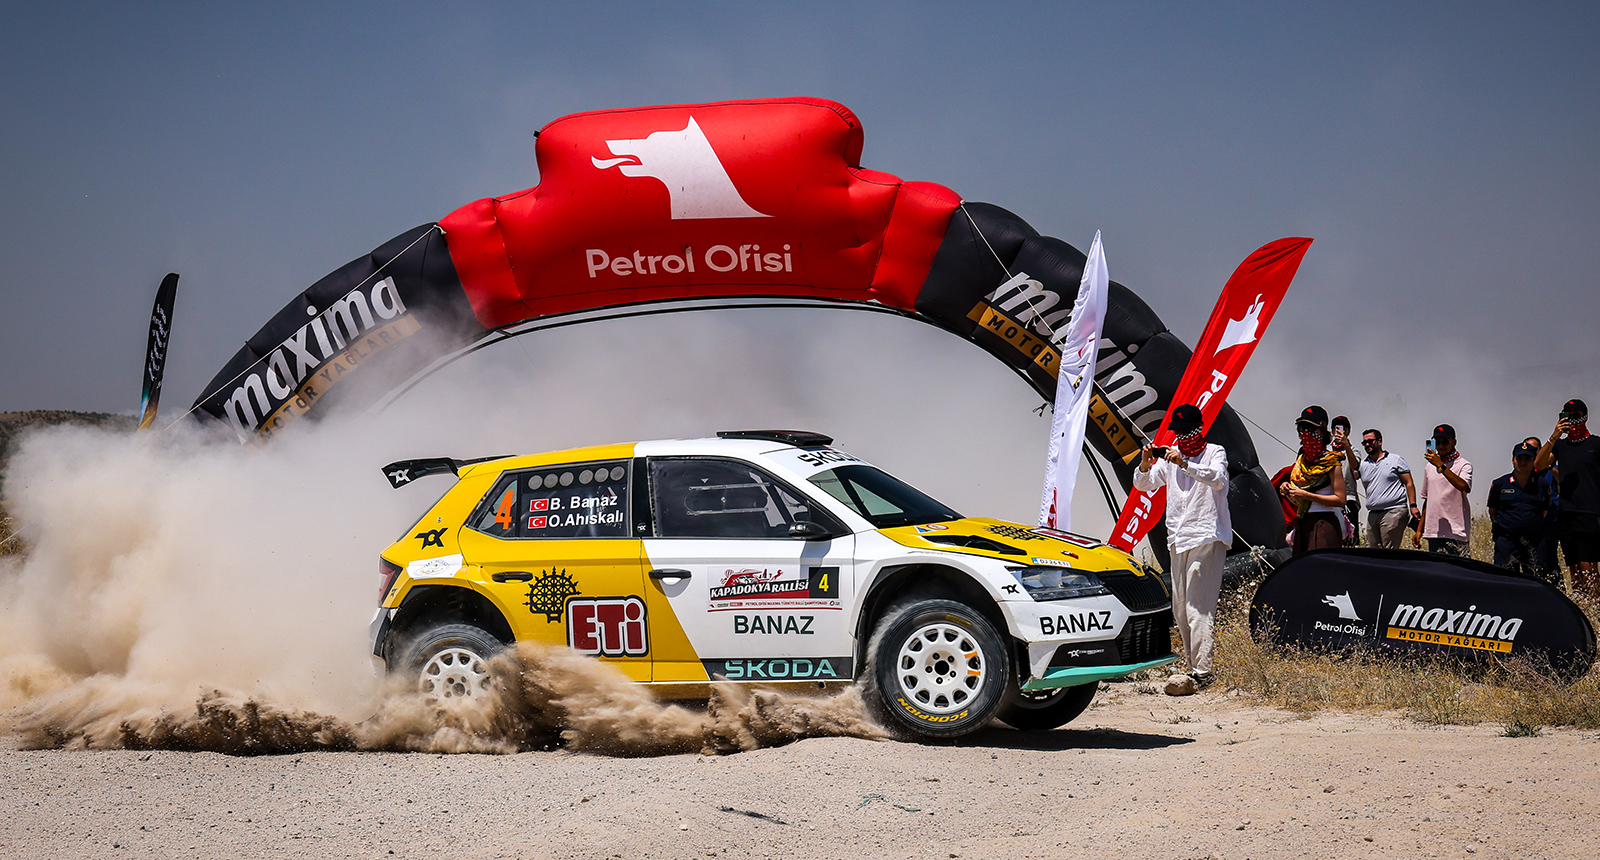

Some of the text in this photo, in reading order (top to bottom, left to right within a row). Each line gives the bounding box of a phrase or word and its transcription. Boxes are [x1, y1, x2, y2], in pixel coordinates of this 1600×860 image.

[586, 244, 793, 278] Petrol Ofisi
[987, 313, 1055, 368] MOTOR
[223, 276, 407, 445] maxima
[259, 325, 402, 442] MOTOR YAĞLARI
[495, 490, 515, 530] 4
[550, 498, 566, 511] B.
[570, 495, 618, 509] Banaz
[711, 582, 771, 598] KAPADOKYA
[818, 573, 829, 592] 4
[734, 615, 815, 635] BANAZ
[1040, 610, 1114, 635] BANAZ
[1315, 621, 1366, 636] Petrol Ofisi
[1388, 604, 1524, 641] maxima
[1399, 630, 1501, 650] MOTOR YAĞLARI
[897, 698, 969, 723] SCORPION
